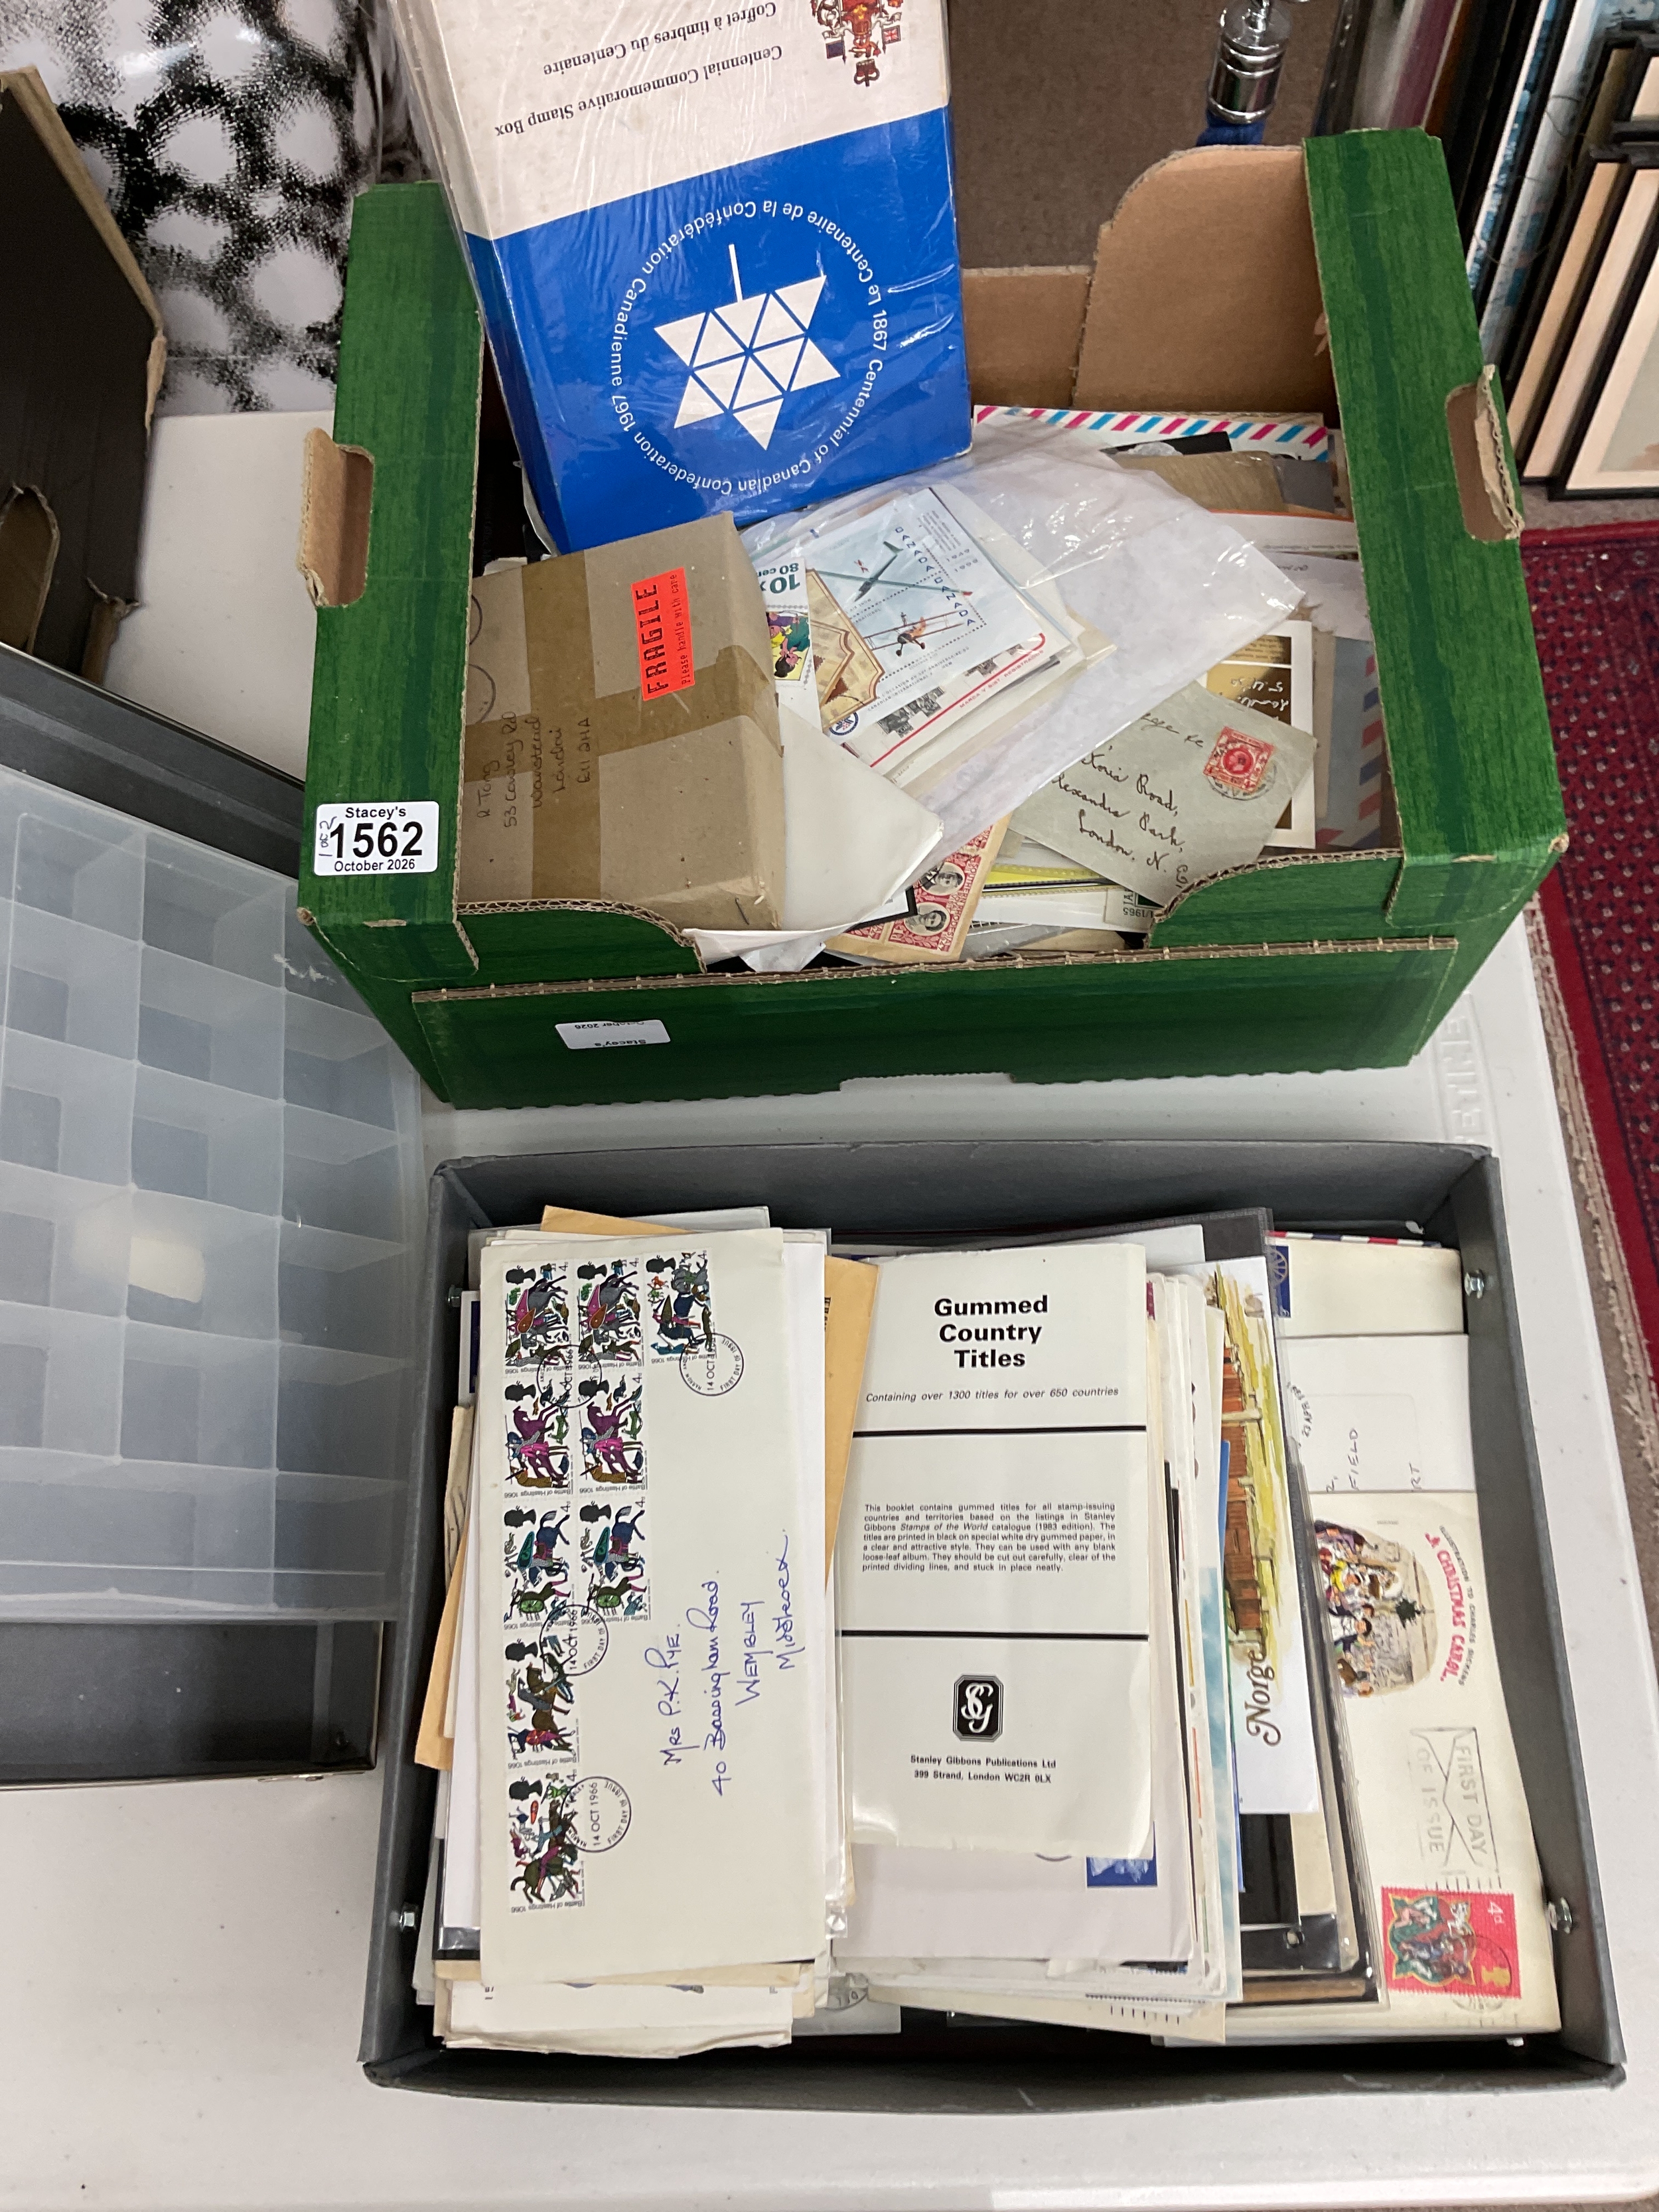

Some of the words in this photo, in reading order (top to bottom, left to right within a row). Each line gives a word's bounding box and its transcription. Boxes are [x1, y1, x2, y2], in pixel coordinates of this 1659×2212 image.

[728, 2, 776, 23] Coffret
[654, 21, 709, 44] timbres
[713, 17, 723, 33] à
[630, 37, 650, 52] du
[543, 44, 626, 75] Centenaire
[703, 45, 782, 80] Centennial
[578, 68, 699, 113] Commemorative
[528, 104, 573, 126] Stamp
[496, 119, 524, 136] Box
[763, 200, 776, 217] la
[783, 203, 803, 221] de
[642, 200, 756, 275] Confédération
[808, 211, 873, 283] Centenaire
[868, 284, 882, 306] Le
[611, 277, 647, 387] Canadienne
[871, 309, 887, 350] 1867
[611, 394, 636, 432] 1967
[829, 359, 883, 446] Centennial
[634, 431, 732, 496] Confederation
[813, 444, 829, 463] of
[739, 459, 812, 492] Canadian
[895, 526, 935, 572] CANADA
[779, 563, 799, 575] 80
[670, 574, 679, 594] care
[671, 597, 683, 618] with
[934, 577, 976, 626] CANADA
[636, 584, 669, 694] FRAGILE
[675, 621, 686, 652] handle
[680, 654, 691, 685] Please
[959, 692, 981, 709] MARCA
[502, 711, 517, 735] Rd
[477, 760, 500, 806] Tong
[1136, 773, 1179, 817] Road,
[345, 806, 407, 820] Stacey's
[476, 808, 490, 818] R
[504, 805, 517, 828] 53
[1052, 772, 1131, 818] lexandra
[1139, 812, 1186, 853] Park,
[330, 821, 423, 859] 1562
[334, 860, 384, 872] October
[387, 858, 415, 870] 2026
[960, 863, 978, 904] SOUTHERN
[951, 892, 963, 915] ROYAL
[944, 904, 964, 947] RHODESIA
[594, 1039, 646, 1047] Stacey's
[934, 1295, 1048, 1317] Gummed
[939, 1323, 1043, 1345] Country
[706, 1359, 715, 1380] OCT
[954, 1349, 1026, 1368] Titles
[707, 1381, 715, 1391] 14
[720, 1374, 734, 1392] FIRST
[866, 1392, 916, 1403] Containing
[948, 1390, 971, 1400] 1300
[975, 1389, 999, 1400] titles
[1003, 1388, 1017, 1399] for
[1049, 1388, 1068, 1398] 650
[1072, 1386, 1119, 1398] countries
[958, 1503, 995, 1512] gummed
[1001, 1503, 1020, 1511] titles
[1058, 1502, 1116, 1512] stamp-issuing
[1035, 1512, 1064, 1522] listings
[1084, 1512, 1116, 1522] Stanley
[864, 1523, 897, 1532] Gibbons
[901, 1523, 930, 1532] Stamps
[934, 1522, 943, 1531] of
[946, 1522, 959, 1531] the
[964, 1522, 989, 1531] World
[991, 1523, 1031, 1532] catalogue
[1035, 1522, 1057, 1531] (1983
[1062, 1522, 1095, 1531] edition).
[1437, 1550, 1466, 1629] CHRISTMAS
[734, 1600, 774, 1706] WEMBLEY
[1244, 1650, 1281, 1747] Norge
[910, 1754, 942, 1766] Stanley
[946, 1755, 982, 1766] Gibbons
[985, 1756, 1038, 1768] Publications
[1042, 1759, 1056, 1769] Ltd
[1417, 1748, 1433, 1775] OF
[712, 1761, 733, 1797] 40
[914, 1769, 929, 1779] 399
[933, 1770, 964, 1781] Strand,
[968, 1771, 1001, 1781] London
[1005, 1773, 1031, 1783] WC2R
[1035, 1773, 1052, 1783] 0LX
[589, 1782, 598, 1805] 1966
[619, 1799, 628, 1808] OF
[1454, 1744, 1479, 1805] FIRST
[1467, 1813, 1488, 1856] DAY
[589, 1810, 601, 1832] OCT
[619, 1810, 628, 1826] DAY
[1420, 1787, 1446, 1854] ISSUE
[592, 1834, 601, 1846] 14
[607, 1826, 623, 1845] FIRST
[1487, 1900, 1504, 1926] 4d
